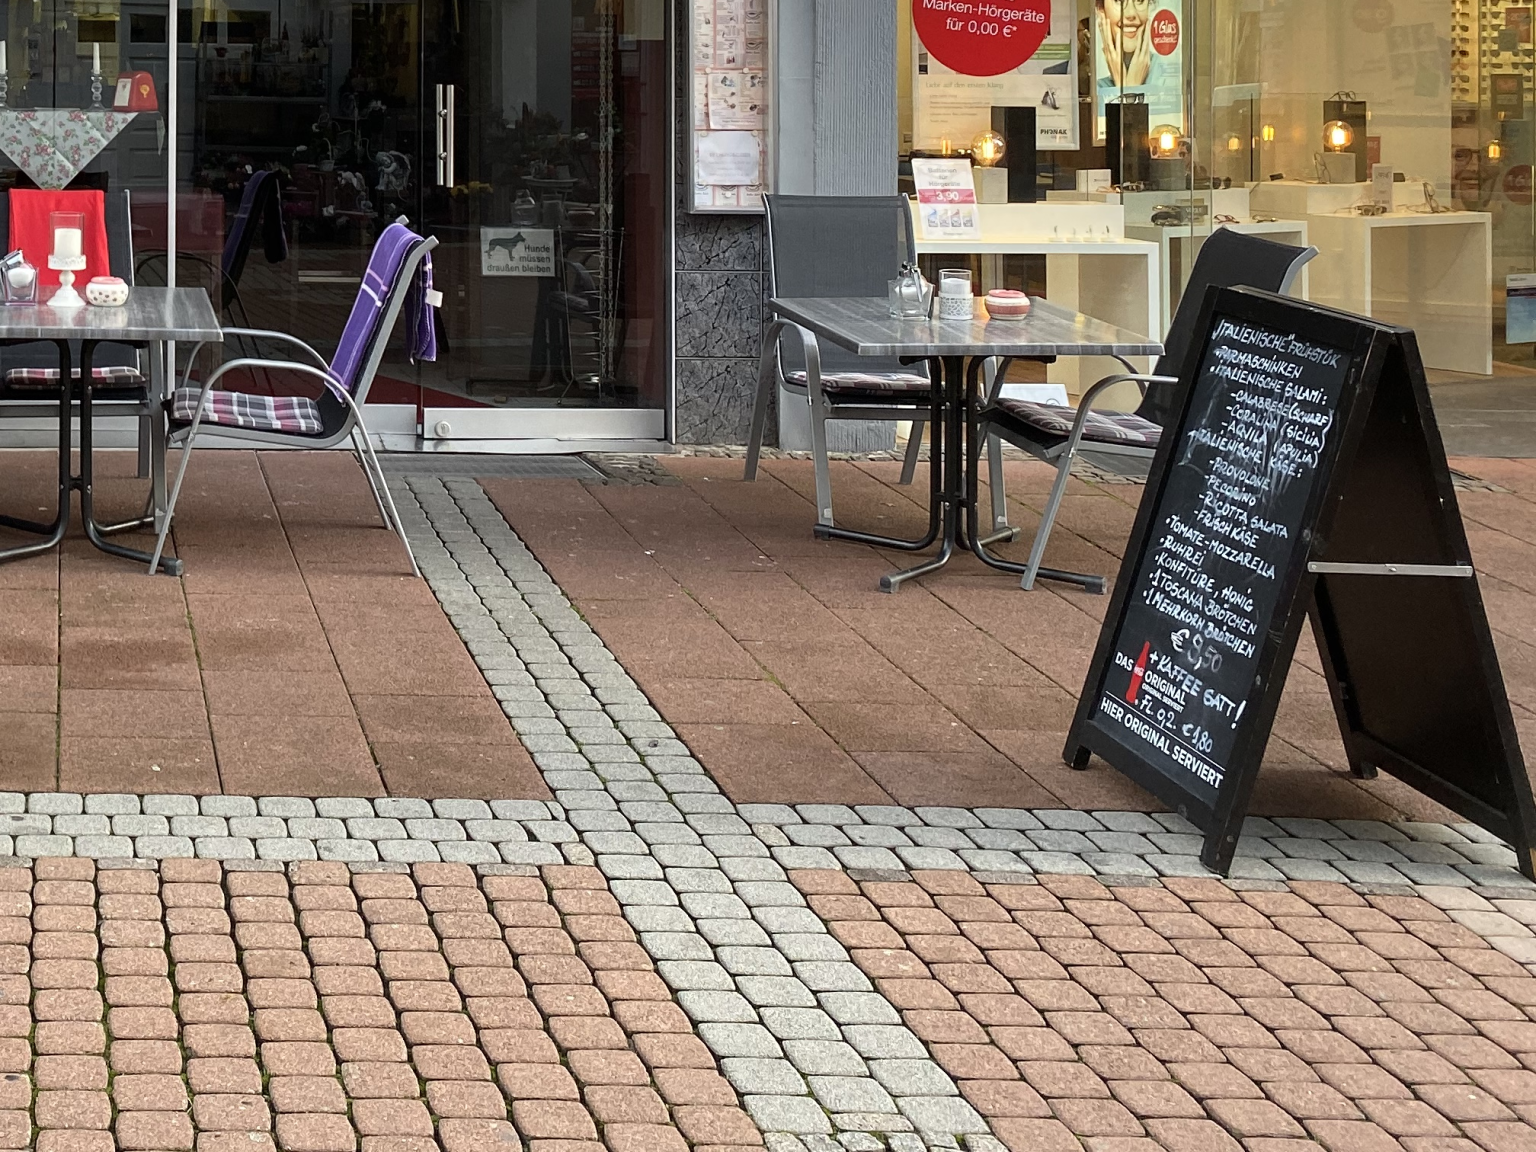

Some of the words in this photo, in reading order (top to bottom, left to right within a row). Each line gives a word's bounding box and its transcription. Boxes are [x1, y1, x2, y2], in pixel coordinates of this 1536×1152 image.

[945, 17, 965, 31] für
[967, 19, 999, 37] 0,00
[936, 191, 959, 202] 3,90
[519, 255, 551, 263] müssen
[524, 244, 551, 253] Hunde
[522, 264, 551, 273] bleiben
[1214, 359, 1285, 393] ITALIENISCHE
[1169, 514, 1276, 580] TOMATE-MOZZARELLA
[1151, 595, 1206, 631] MEHRKORN
[1159, 572, 1204, 611] TOSCANA
[1204, 599, 1258, 636] BRÖTCHEN
[1221, 585, 1254, 613] HONIG
[1115, 651, 1135, 672] DAS
[1156, 654, 1204, 697] KAFFEE
[1144, 670, 1186, 706] ORIGINAL
[1100, 696, 1123, 723] HIER
[1124, 713, 1171, 755] ORIGINAL
[1171, 747, 1224, 790] SERVIERT
